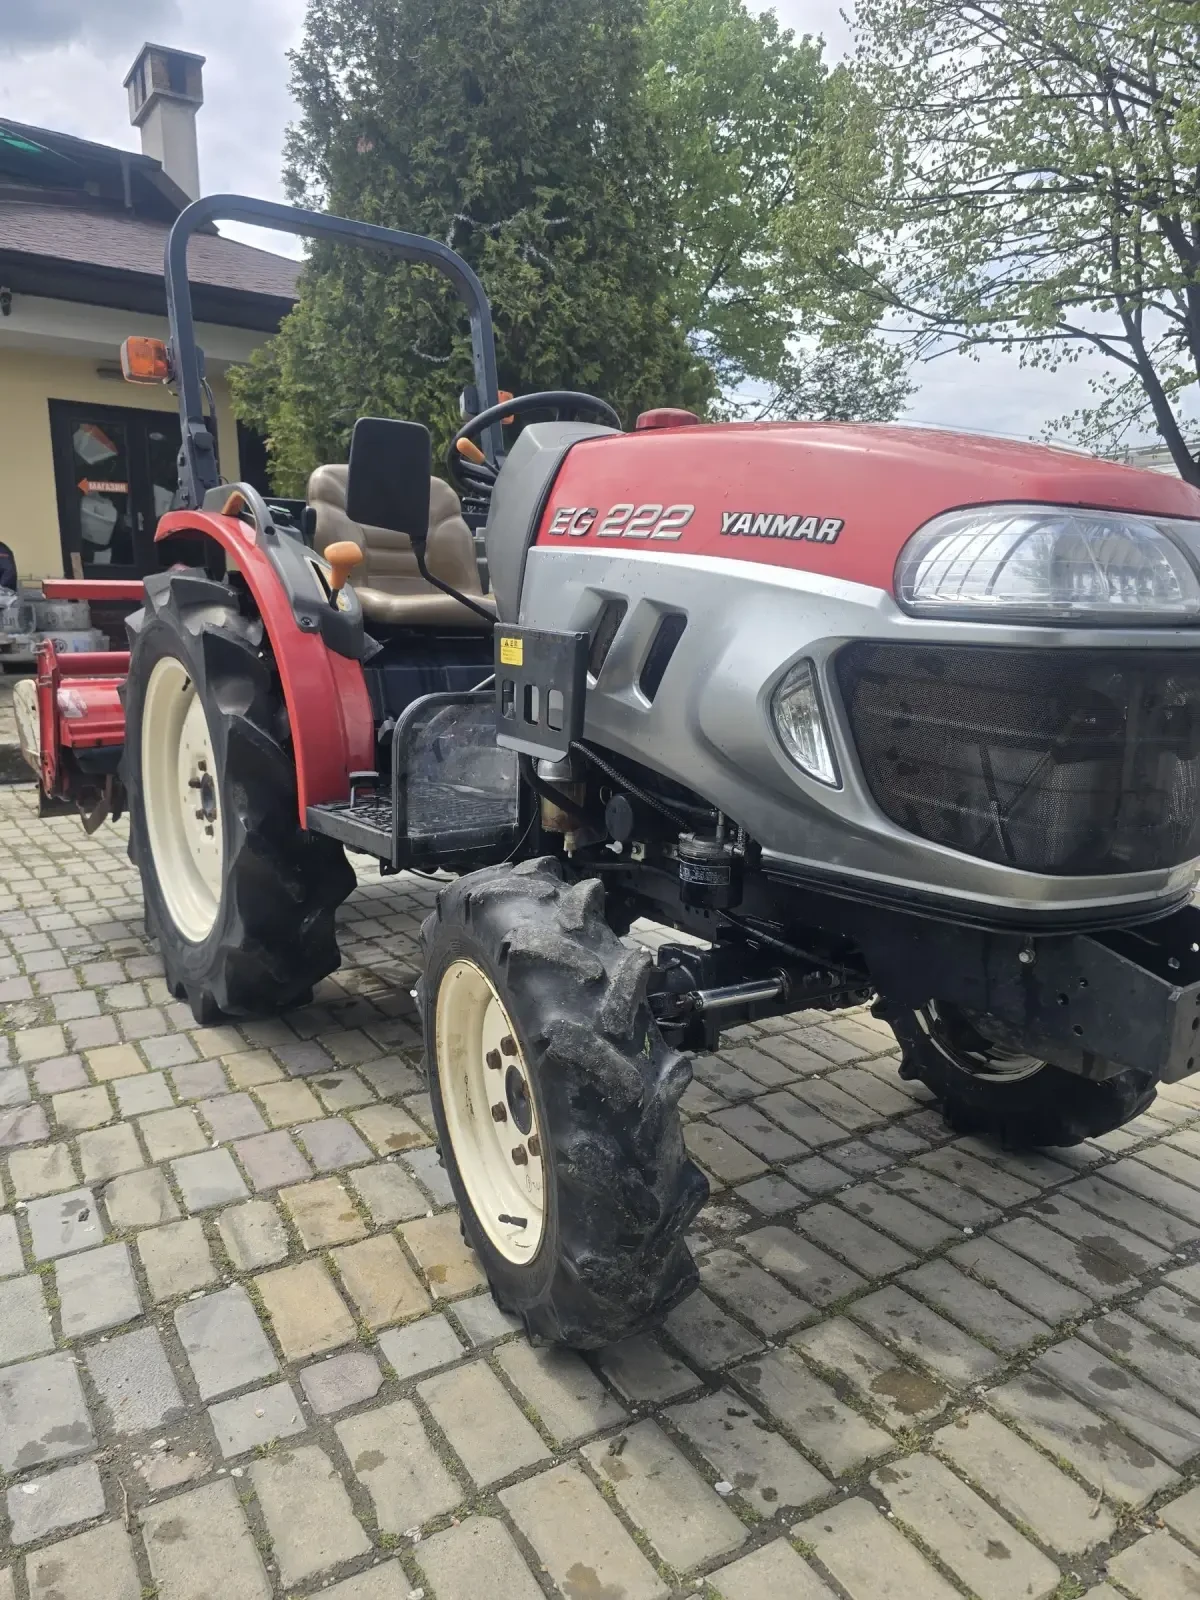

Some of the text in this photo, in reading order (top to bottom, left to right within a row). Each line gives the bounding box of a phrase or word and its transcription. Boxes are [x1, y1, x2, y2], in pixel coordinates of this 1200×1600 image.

[88, 481, 126, 493] МАГАЗИН
[548, 502, 695, 540] EG 222
[720, 511, 845, 544] YANMAR
